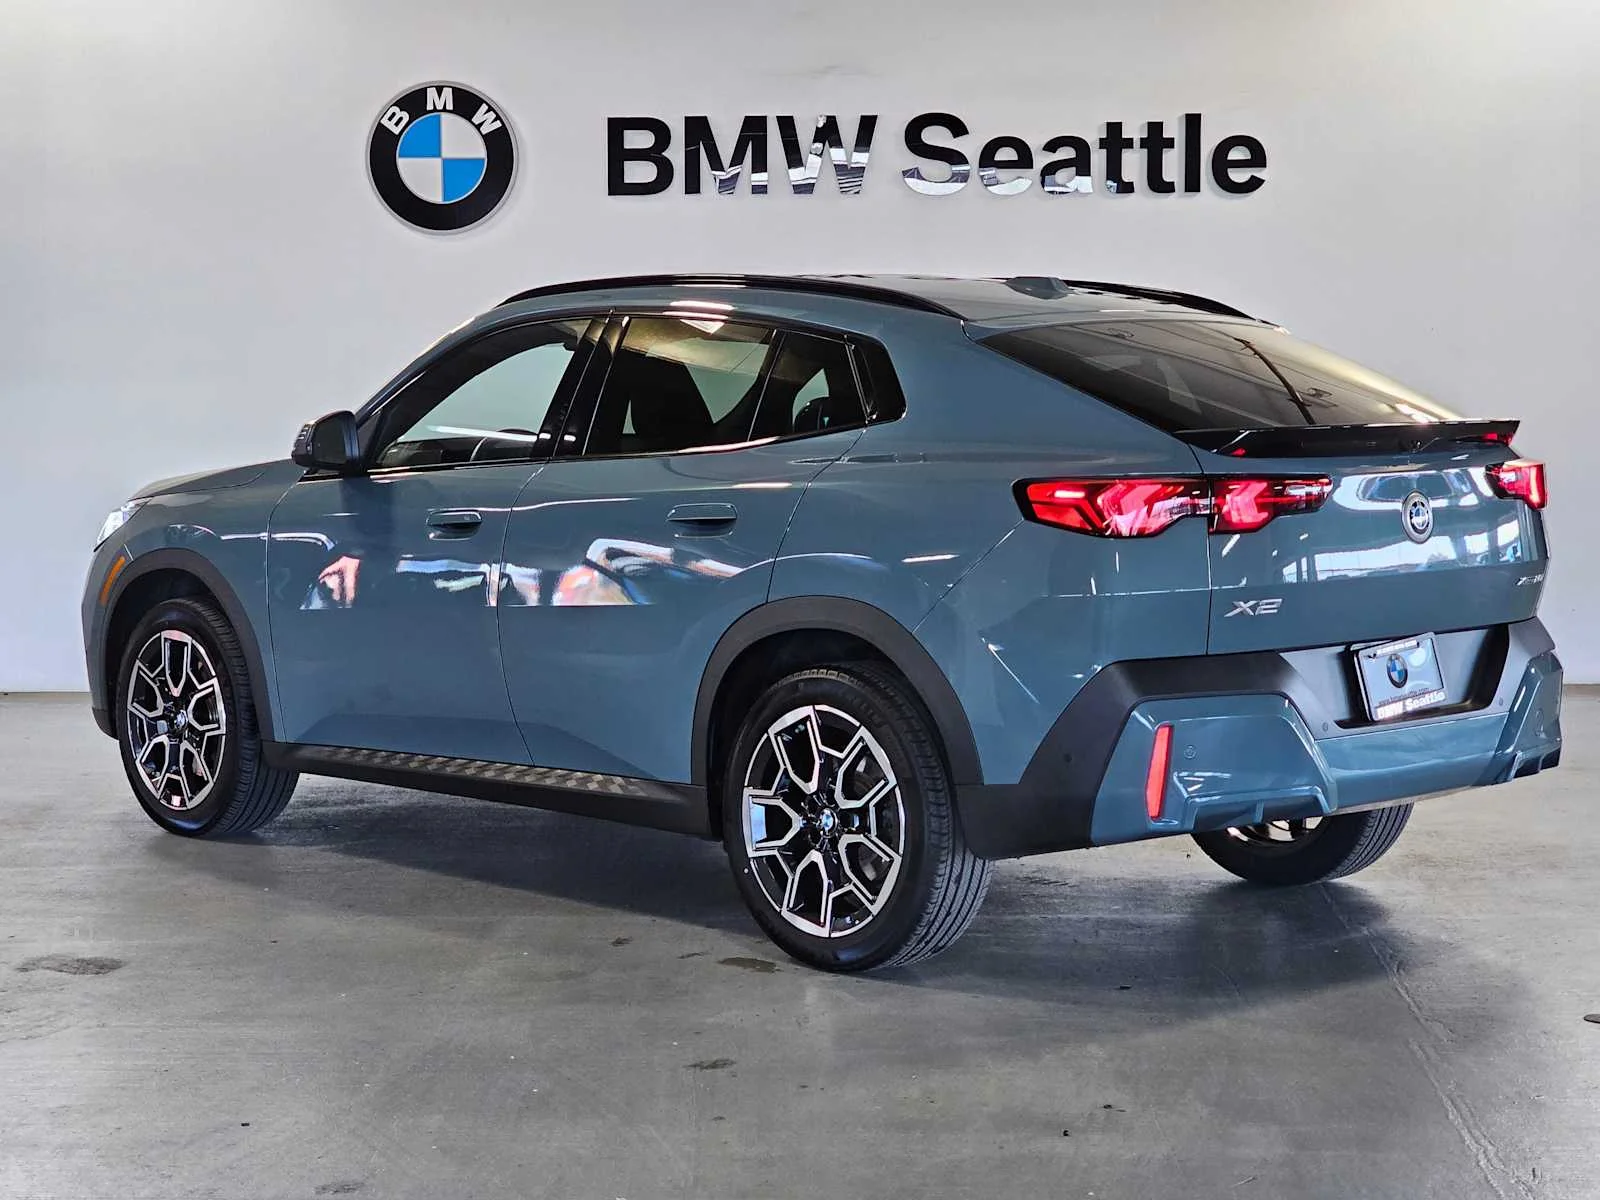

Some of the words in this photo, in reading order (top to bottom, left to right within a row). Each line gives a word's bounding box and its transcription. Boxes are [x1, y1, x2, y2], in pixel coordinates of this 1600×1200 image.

[380, 87, 502, 136] BMW
[607, 115, 878, 196] BMW
[902, 112, 1267, 196] Seattle
[1223, 598, 1283, 618] X2
